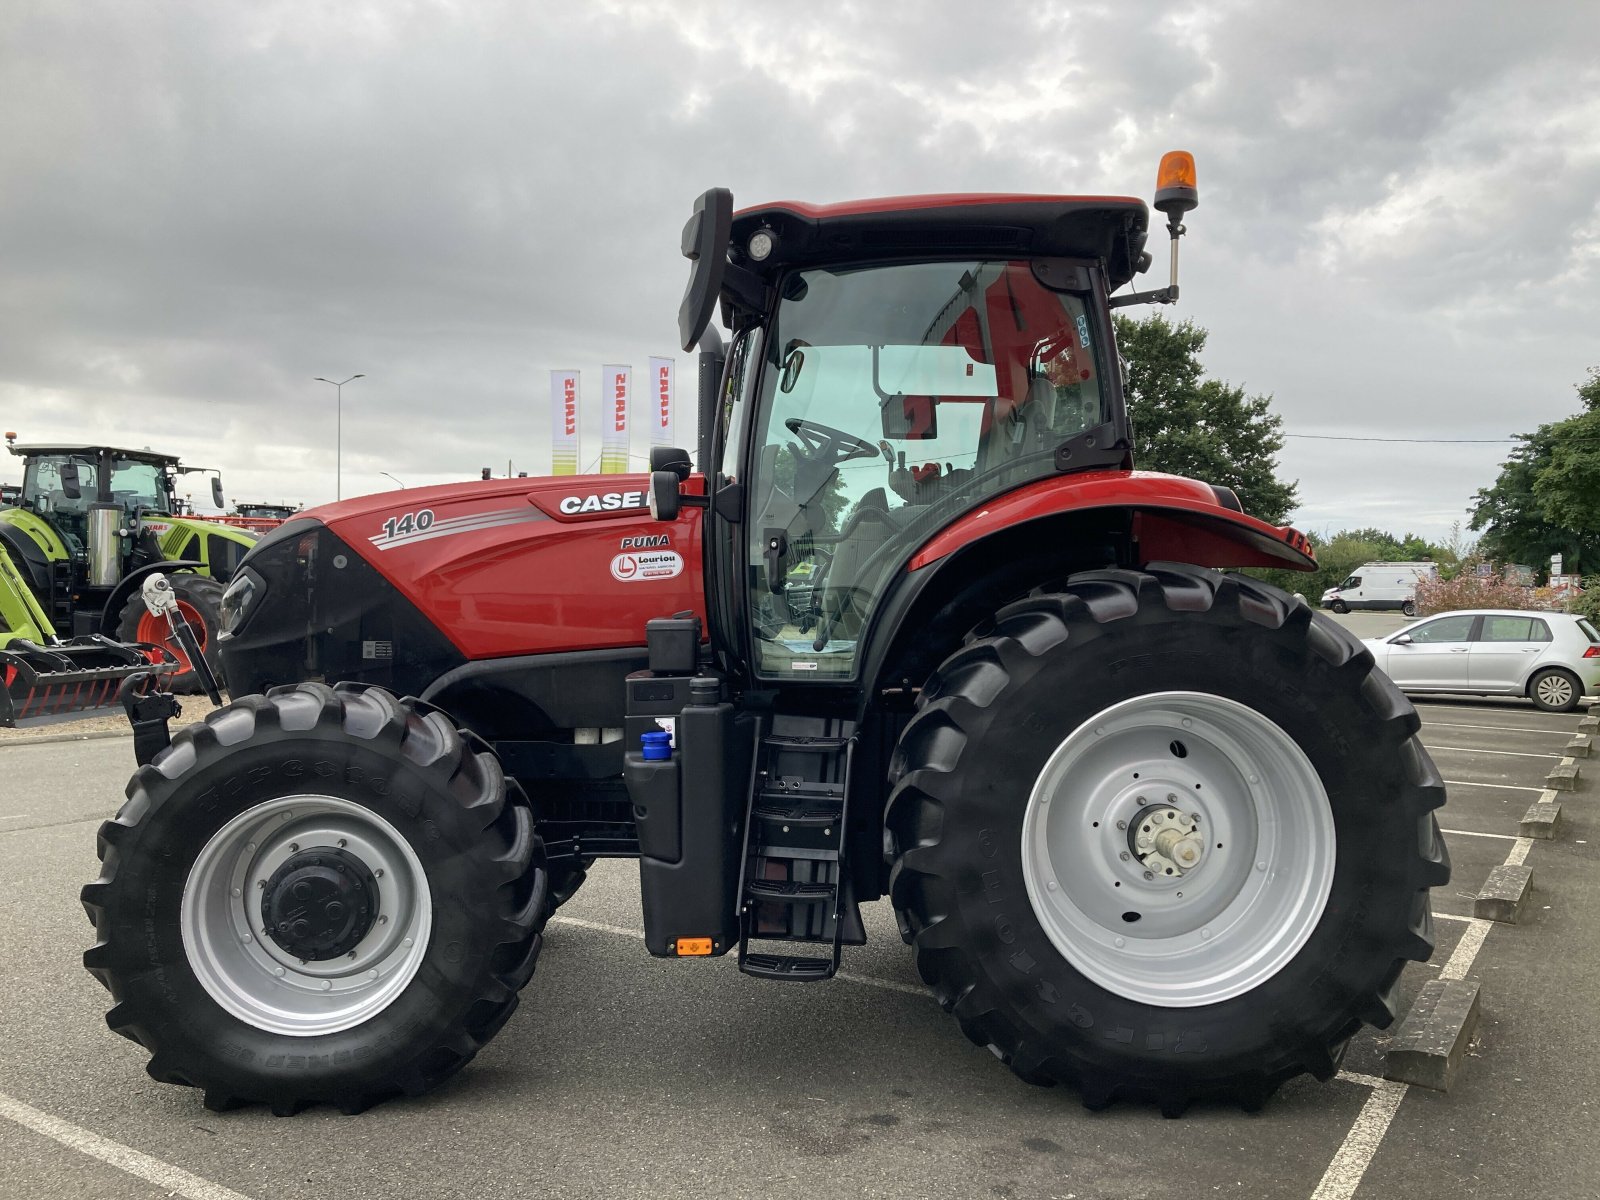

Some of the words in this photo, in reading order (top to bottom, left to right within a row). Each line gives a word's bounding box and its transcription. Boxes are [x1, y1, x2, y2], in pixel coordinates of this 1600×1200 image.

[559, 491, 642, 514] CASE
[382, 508, 435, 540] 140
[620, 534, 670, 549] PUMA
[638, 555, 676, 564] Louriou
